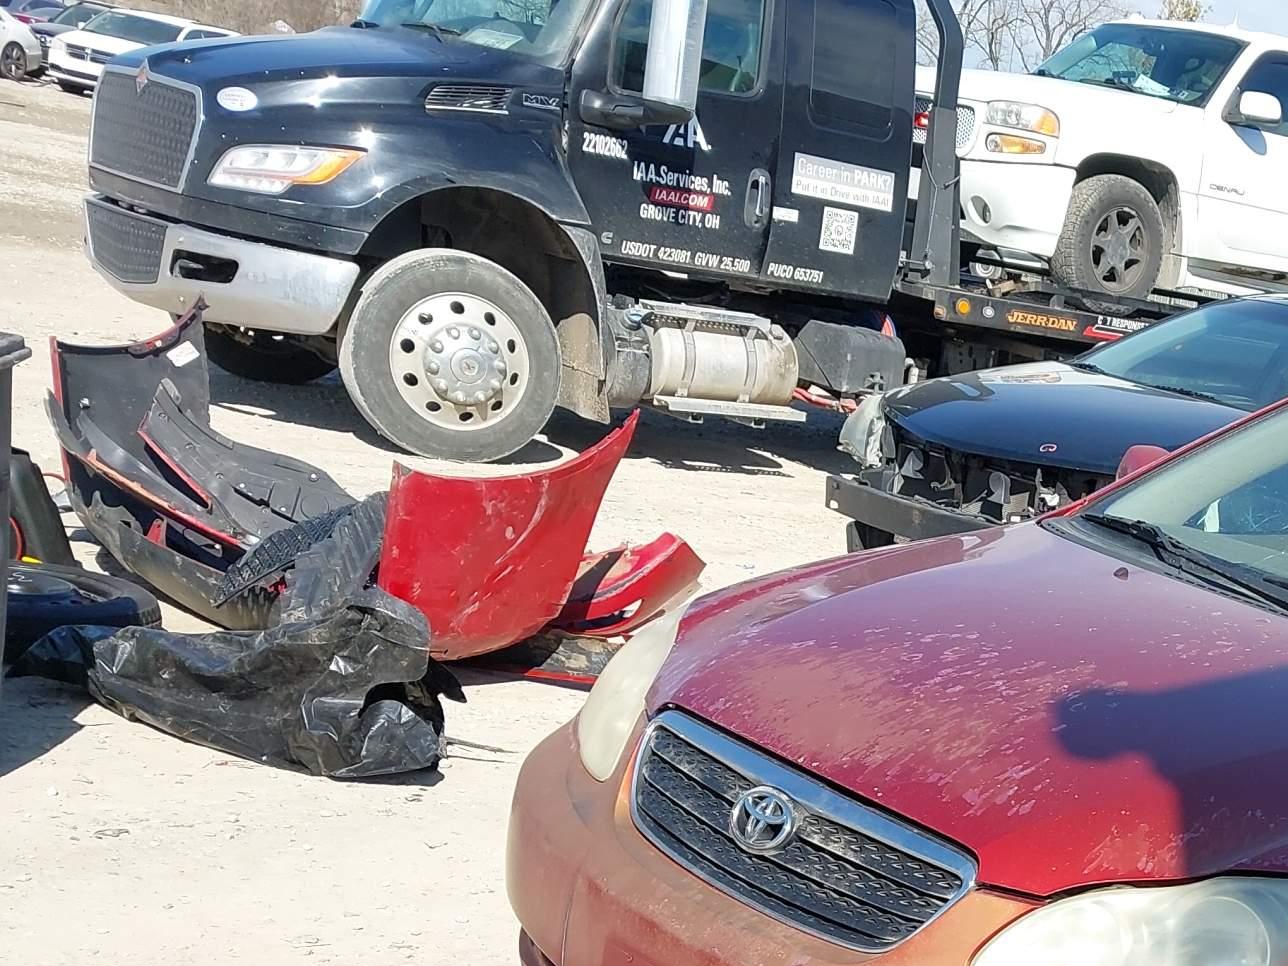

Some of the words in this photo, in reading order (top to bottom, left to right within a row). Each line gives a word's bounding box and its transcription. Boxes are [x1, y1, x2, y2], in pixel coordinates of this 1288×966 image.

[632, 160, 656, 183] IAA
[659, 165, 711, 194] Services,
[712, 173, 732, 196] Inc.
[798, 157, 838, 179] Career
[841, 166, 851, 182] in
[853, 168, 892, 190] PARK?
[655, 188, 709, 208] IAAI.COM
[796, 179, 811, 192] Put
[831, 186, 850, 199] Drive
[640, 203, 676, 223] GROVE
[678, 209, 703, 228] CITY,
[705, 213, 720, 229] OH
[621, 240, 657, 258] USDOT
[657, 246, 690, 264] 423081
[694, 252, 721, 268] GVW
[720, 257, 751, 273] 25,500
[767, 262, 793, 279] PUCO
[794, 267, 824, 284] 653751
